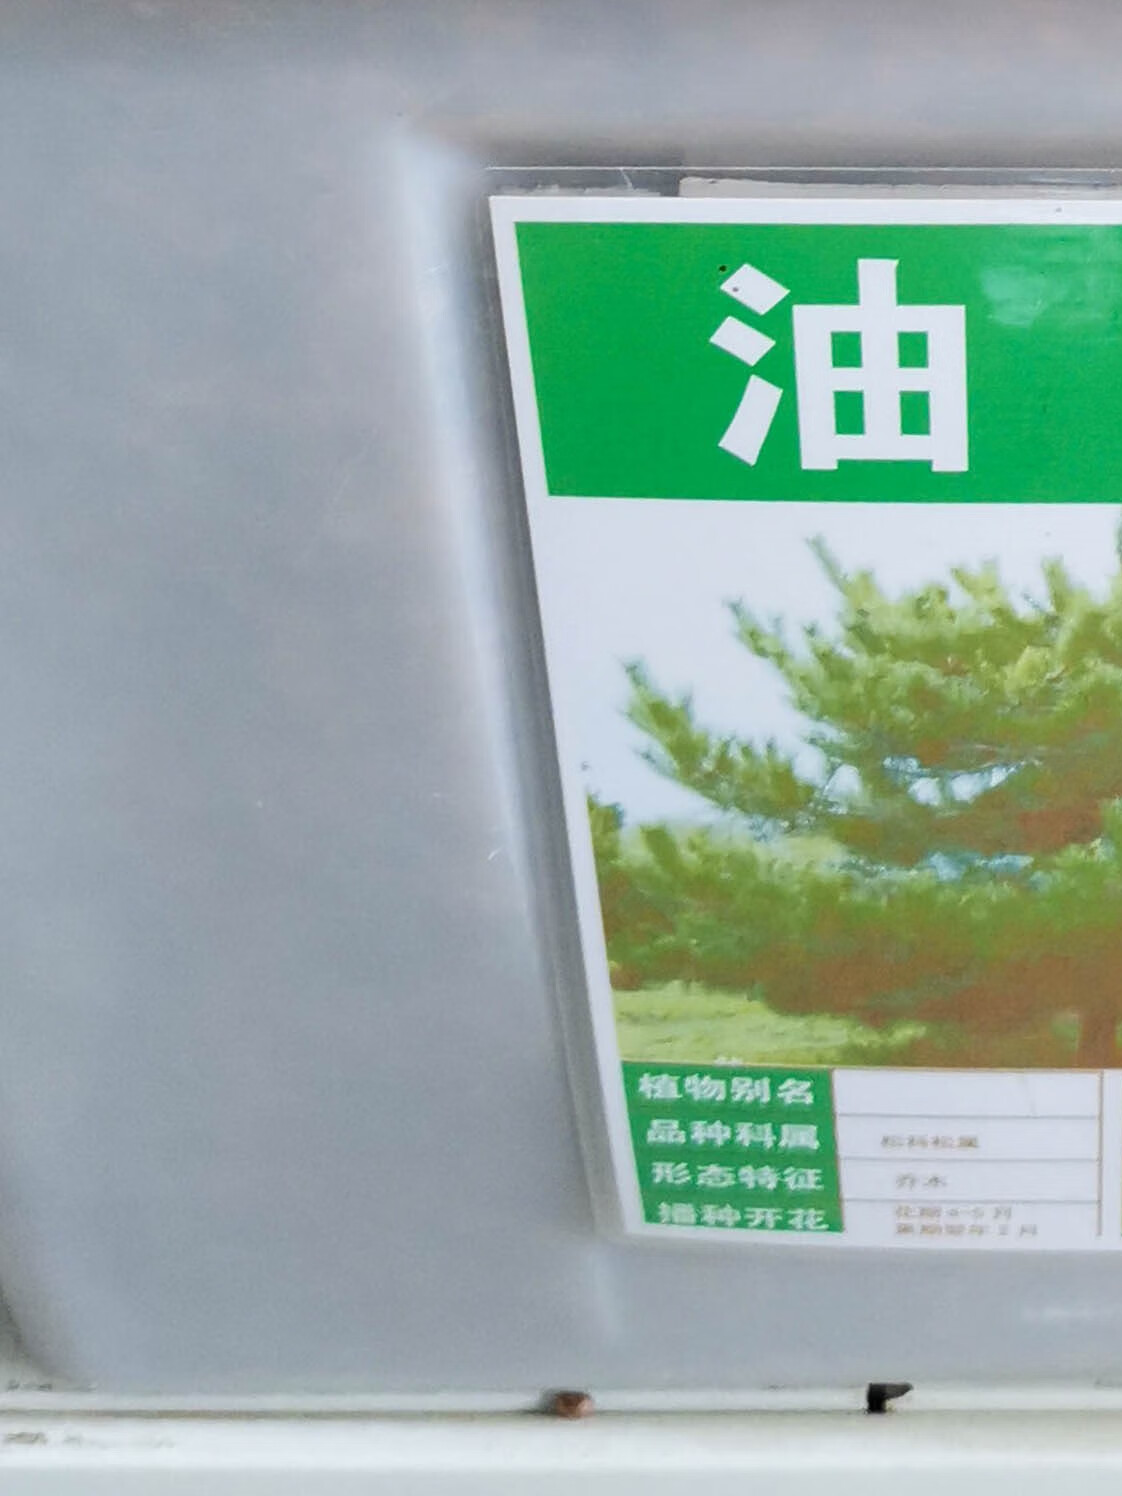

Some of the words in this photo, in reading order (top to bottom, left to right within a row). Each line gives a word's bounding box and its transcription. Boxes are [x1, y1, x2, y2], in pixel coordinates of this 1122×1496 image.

[638, 1072, 814, 1105] 植物别名
[647, 1118, 820, 1150] 品种科属
[650, 1161, 825, 1190] 形态特征
[658, 1201, 829, 1231] 播种开花
